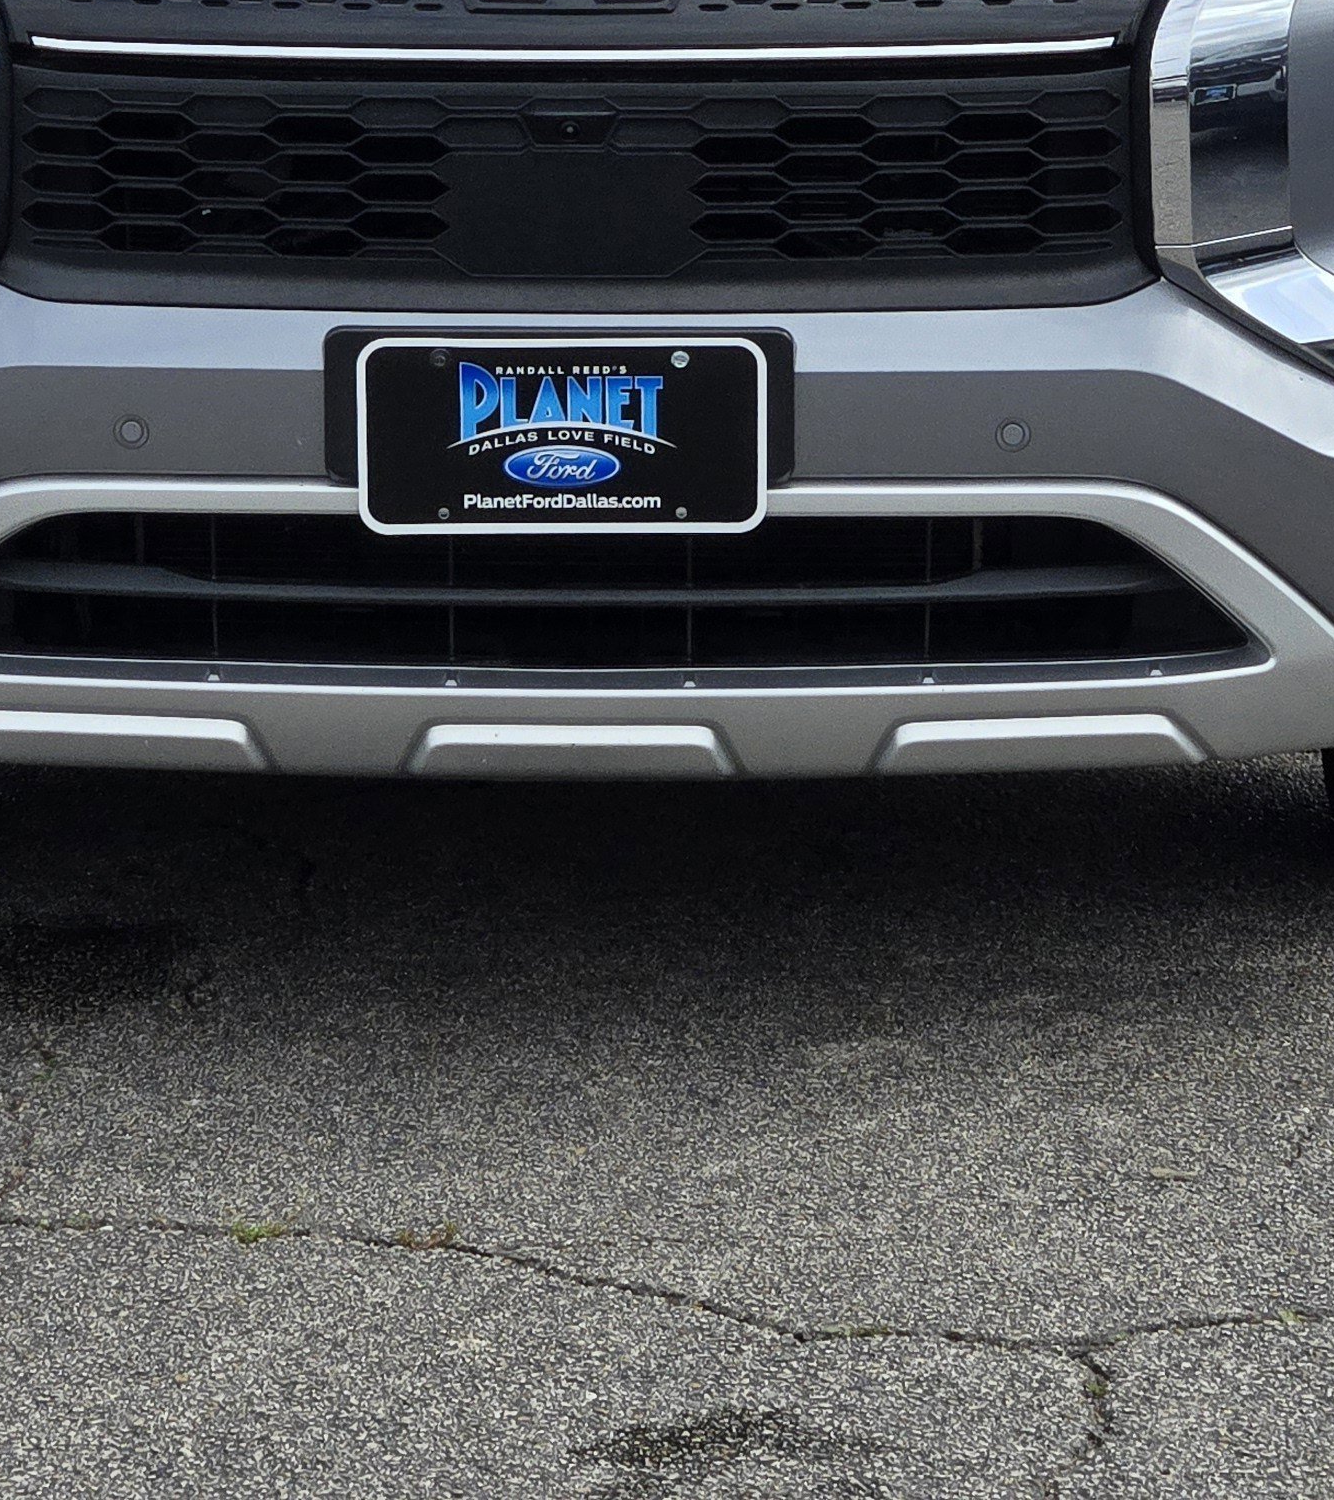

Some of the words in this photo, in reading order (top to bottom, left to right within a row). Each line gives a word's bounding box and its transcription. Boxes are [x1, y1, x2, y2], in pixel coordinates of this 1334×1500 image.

[495, 366, 565, 375] RANDALL
[459, 361, 664, 442] PLANET
[468, 430, 539, 456] DALLAS
[547, 430, 595, 442] LOVE
[603, 433, 656, 455] FIELD
[525, 450, 599, 481] Ford
[463, 493, 662, 509] PlanetFordDallas.com
